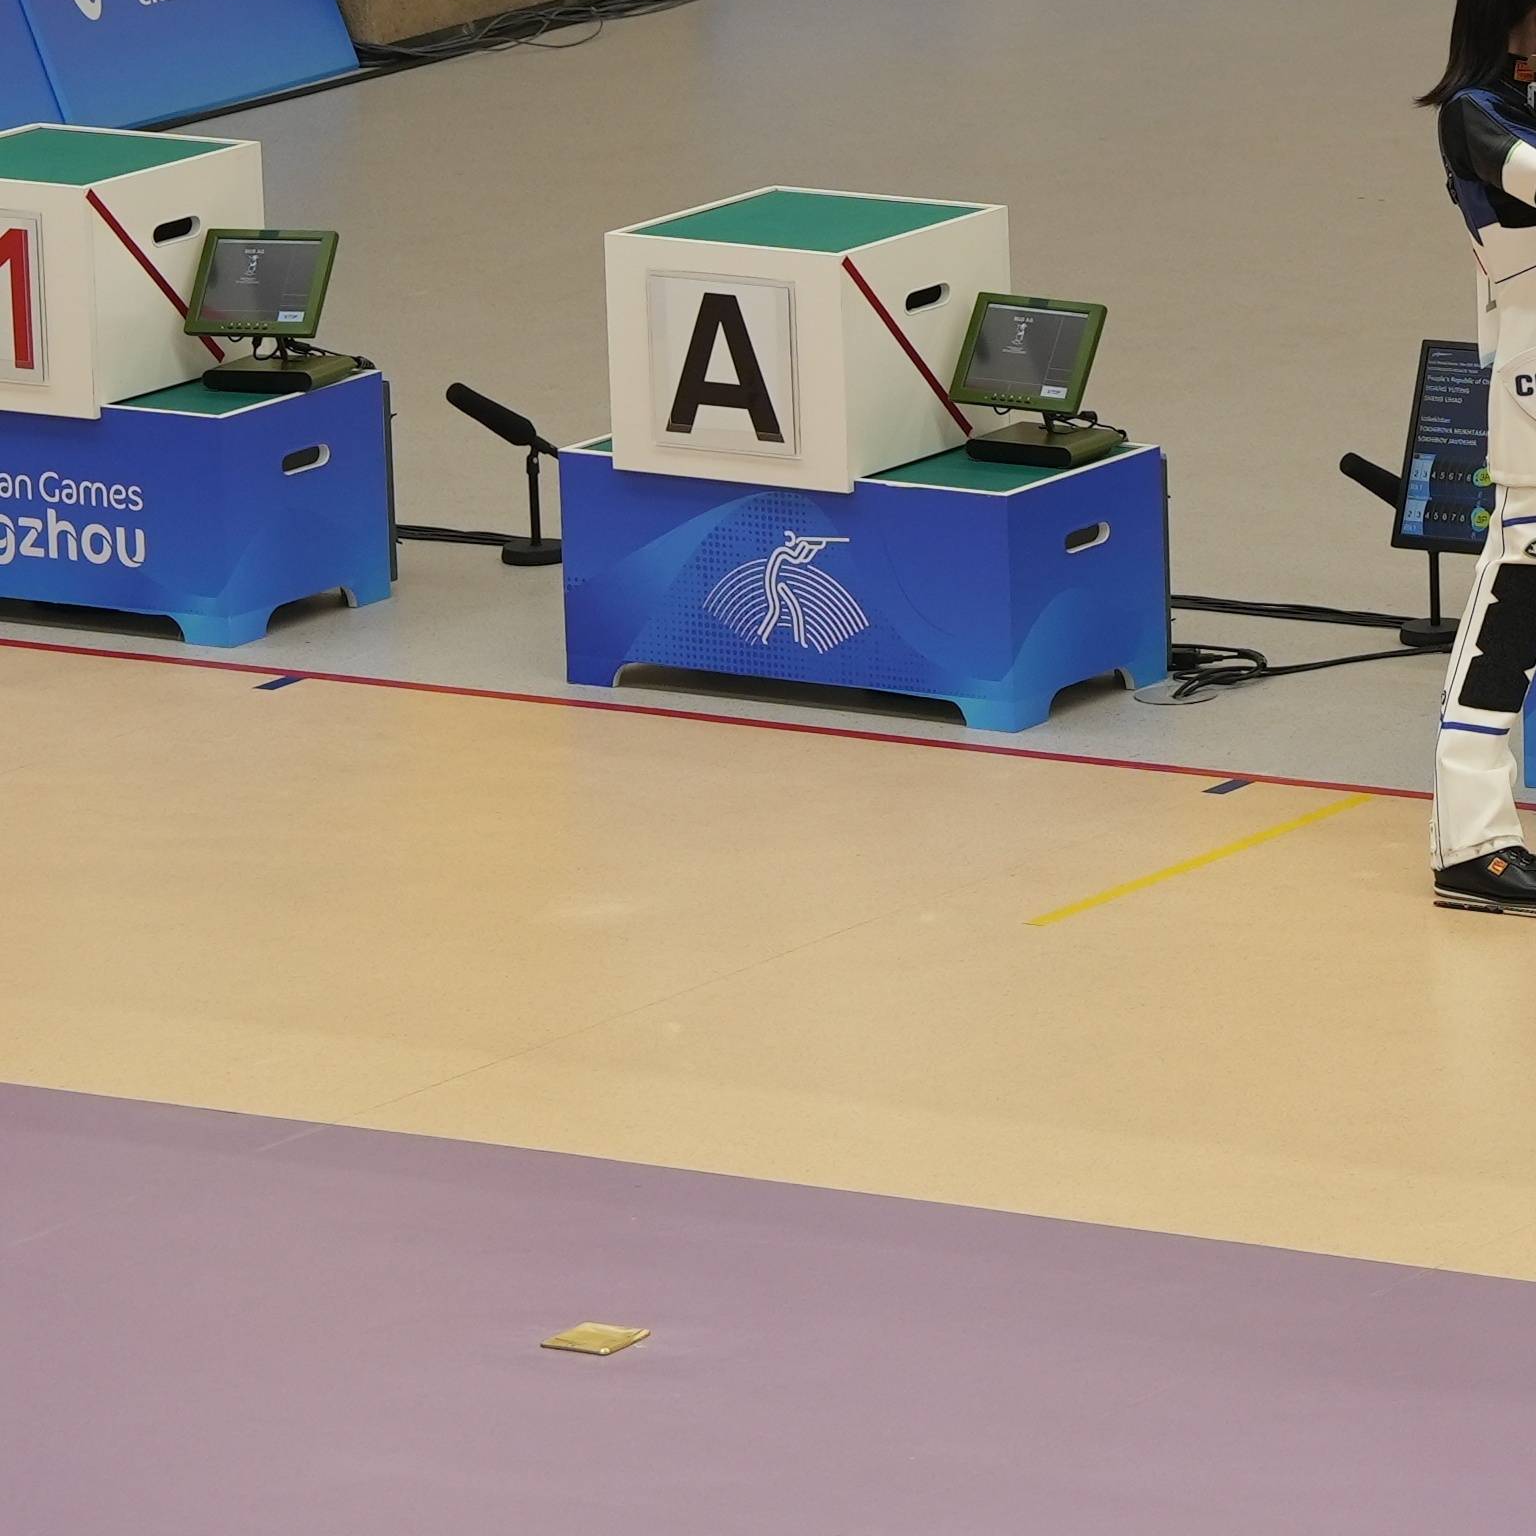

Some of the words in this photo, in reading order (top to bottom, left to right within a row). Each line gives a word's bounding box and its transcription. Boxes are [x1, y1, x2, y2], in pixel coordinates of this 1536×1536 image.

[0, 228, 34, 369] 1
[666, 293, 785, 443] A
[39, 471, 144, 511] Games
